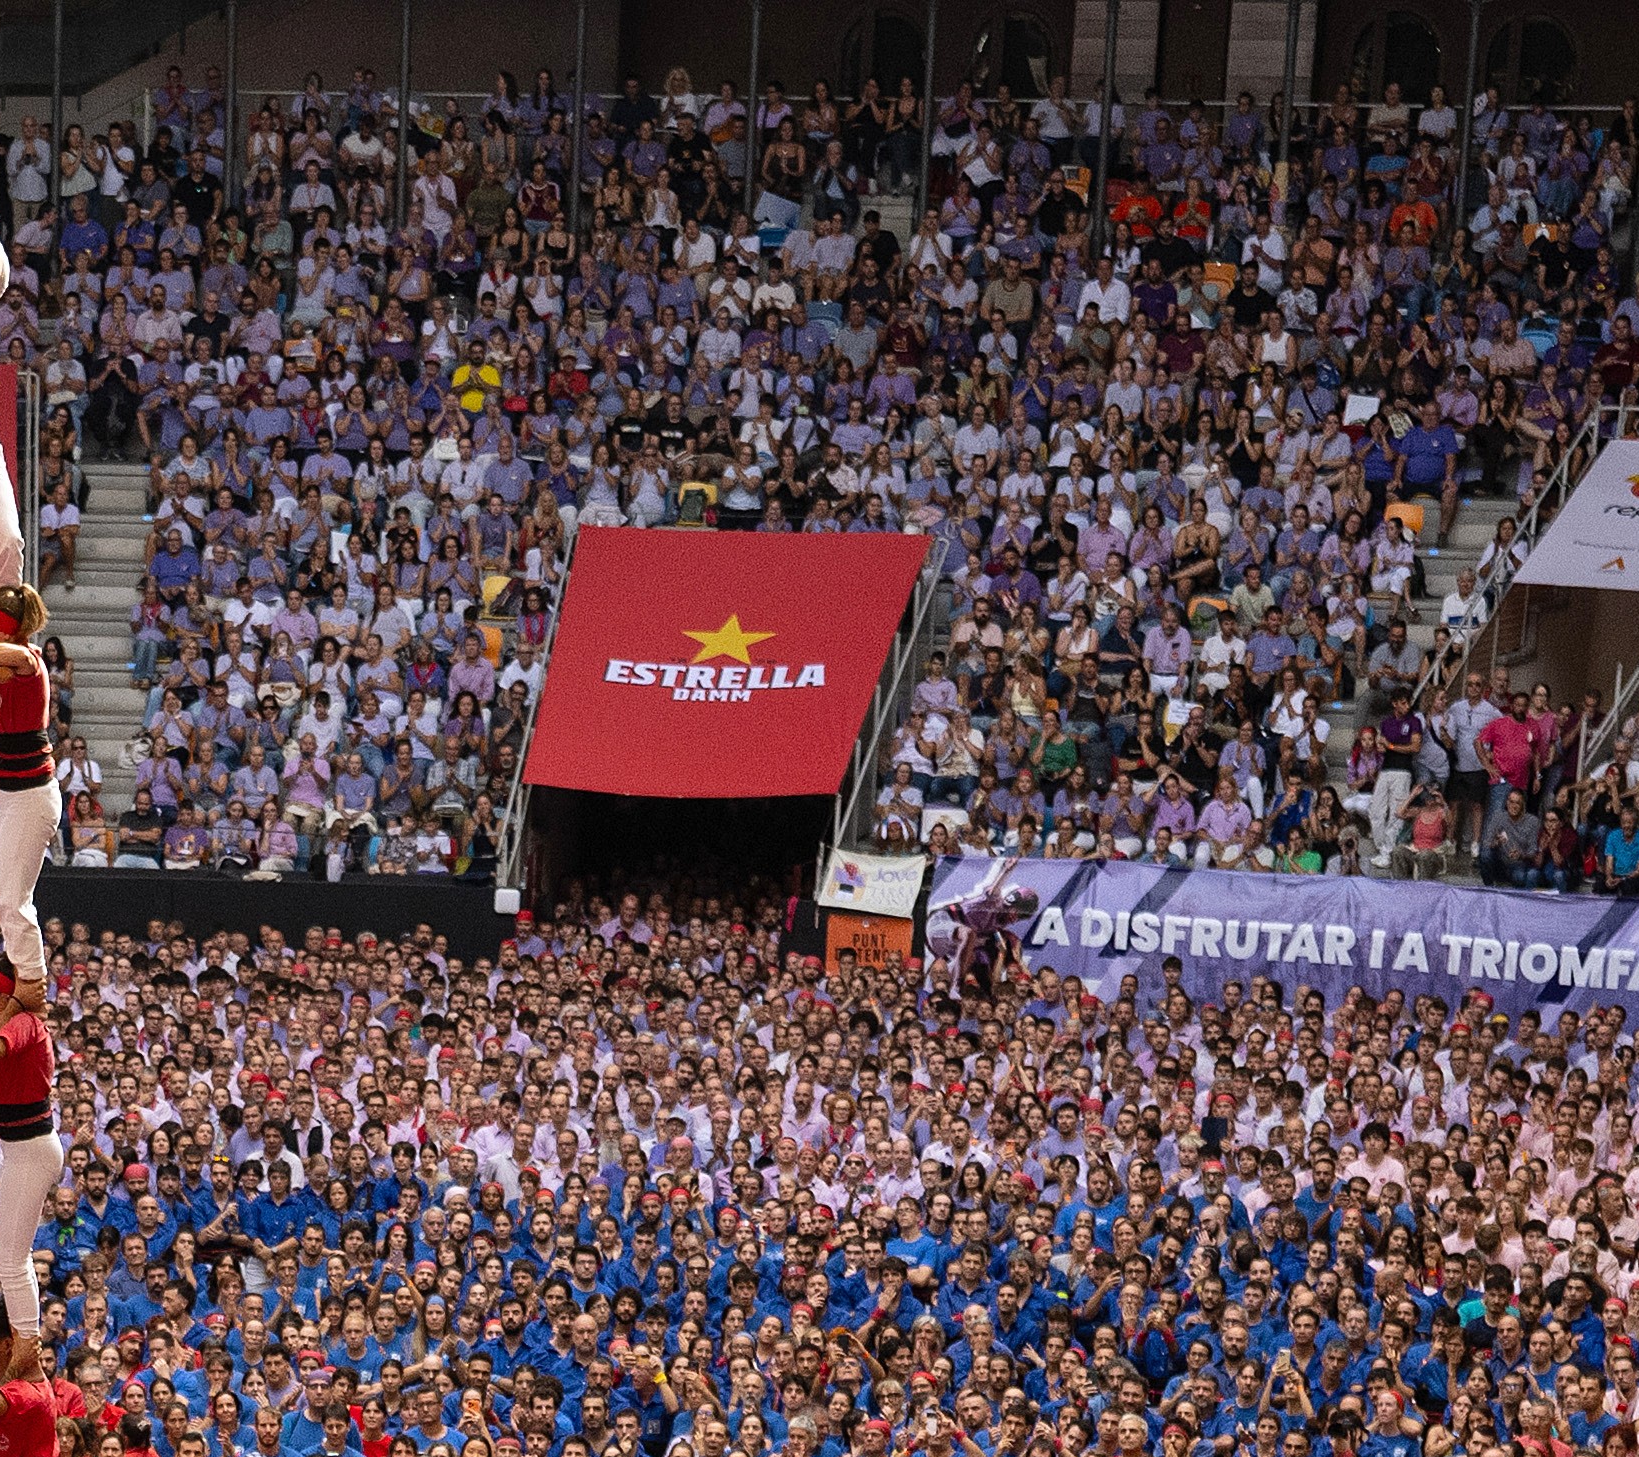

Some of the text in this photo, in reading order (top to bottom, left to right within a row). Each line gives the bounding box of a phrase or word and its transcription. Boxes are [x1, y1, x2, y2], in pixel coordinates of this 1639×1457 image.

[604, 659, 825, 690] ESTRELLA
[673, 689, 752, 702] DAMM
[853, 934, 886, 947] PUNT
[1032, 906, 1071, 948] A
[1079, 908, 1357, 967] DISFRUTAR
[1369, 930, 1385, 969] I
[1392, 932, 1430, 973] A
